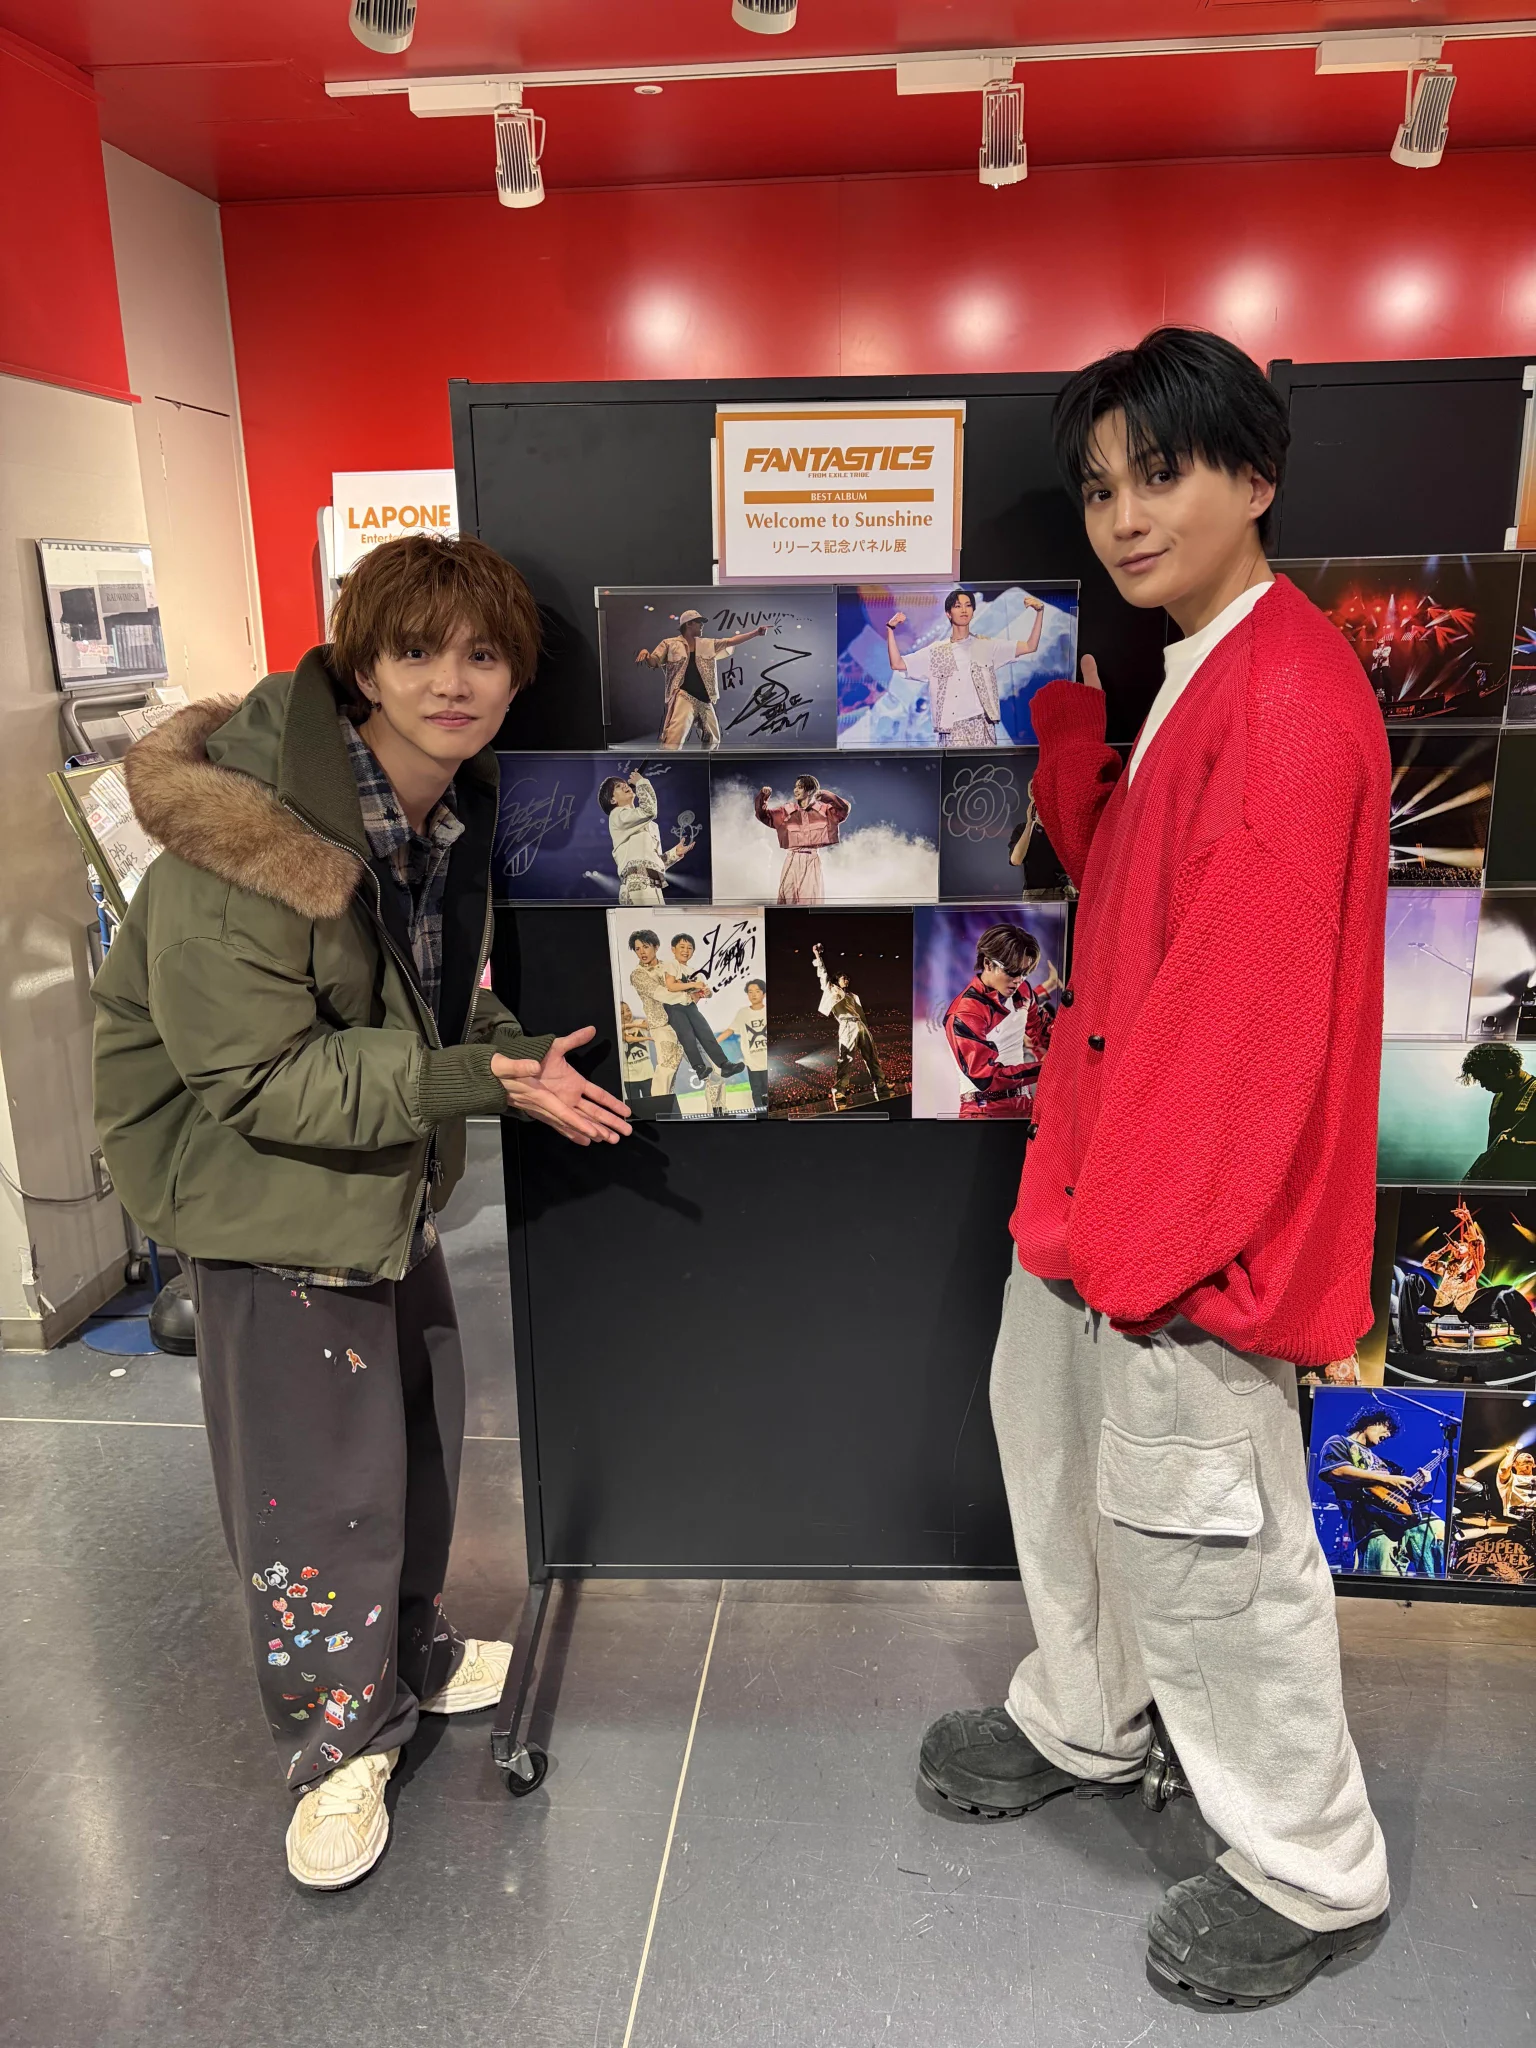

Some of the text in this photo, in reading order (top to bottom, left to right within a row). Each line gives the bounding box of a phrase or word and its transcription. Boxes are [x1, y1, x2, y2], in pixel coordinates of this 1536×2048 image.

[744, 445, 935, 472] FANTASTICS
[810, 492, 867, 501] BEST ALBUM
[348, 505, 451, 529] LAPONE
[745, 510, 933, 529] Welcome to Sunshine
[772, 538, 907, 554] リリース記念パネル展
[631, 1049, 644, 1060] PG
[1475, 1540, 1525, 1555] SUPER
[1466, 1551, 1529, 1567] BEAVER
